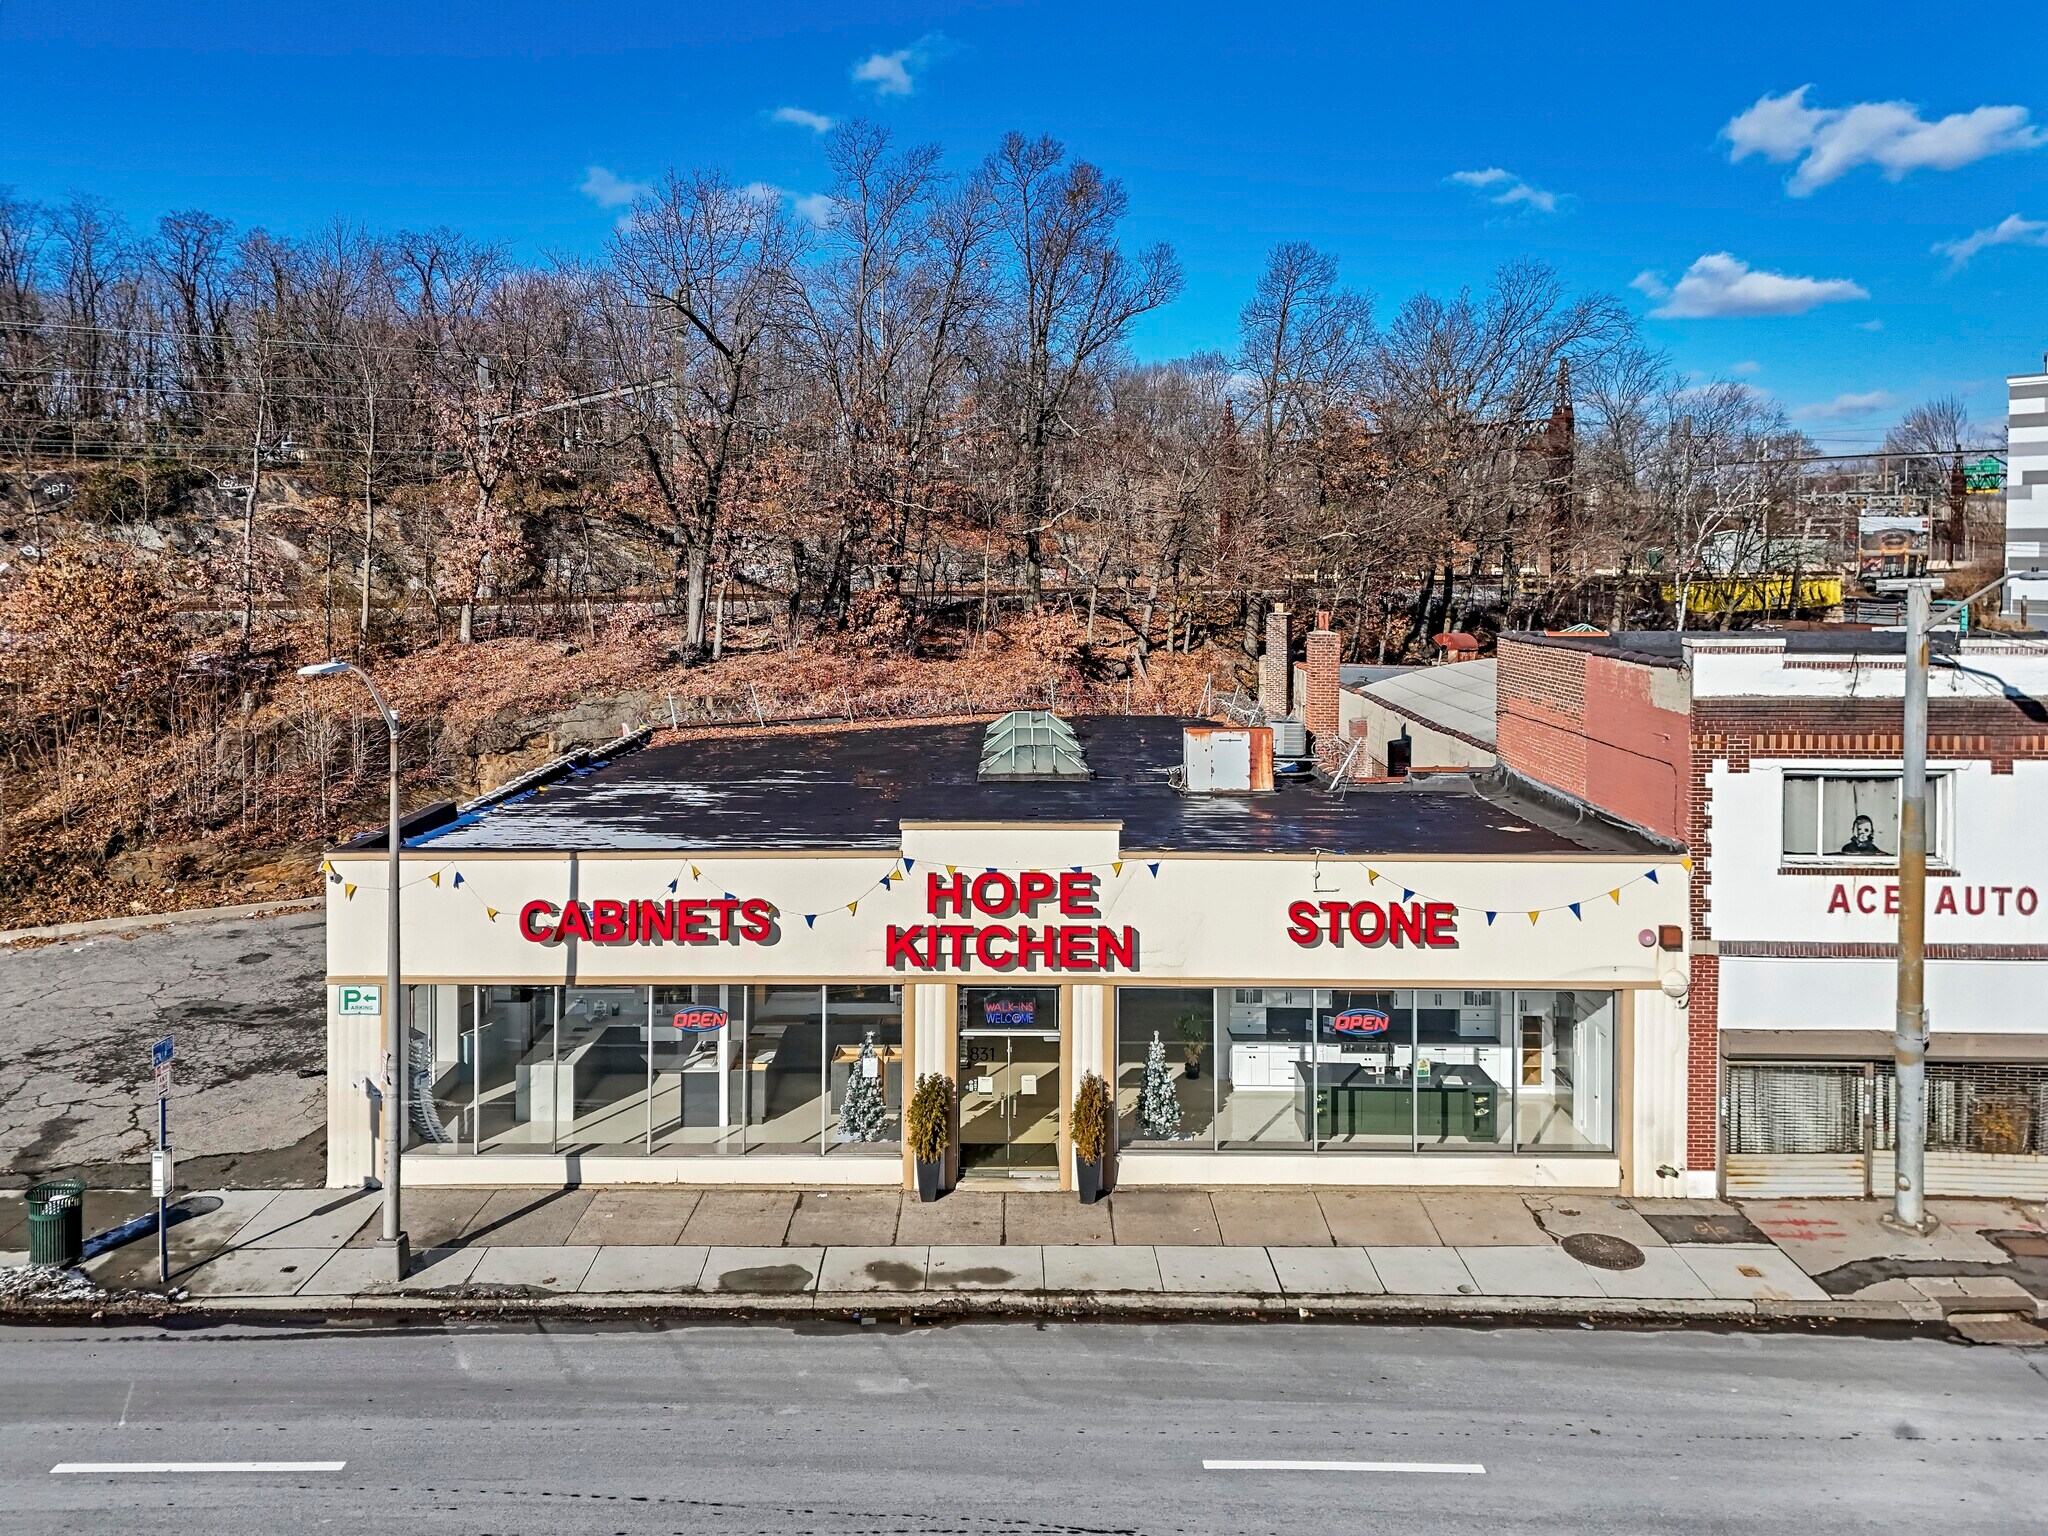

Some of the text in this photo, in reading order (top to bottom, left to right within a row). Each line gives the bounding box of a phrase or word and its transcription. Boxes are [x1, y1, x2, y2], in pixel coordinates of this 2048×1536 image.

[927, 871, 1094, 914] HOPE
[1827, 884, 2039, 916] ACE AUTO
[519, 899, 772, 943] CABINETS
[1287, 901, 1456, 945] STONE
[886, 924, 1133, 968] KITCHEN
[673, 1010, 728, 1029] OPEN
[985, 1002, 1034, 1012] WALK-INS
[985, 1013, 1034, 1024] WELCOME
[1334, 1013, 1390, 1032] OPEN
[969, 1046, 995, 1061] 831
